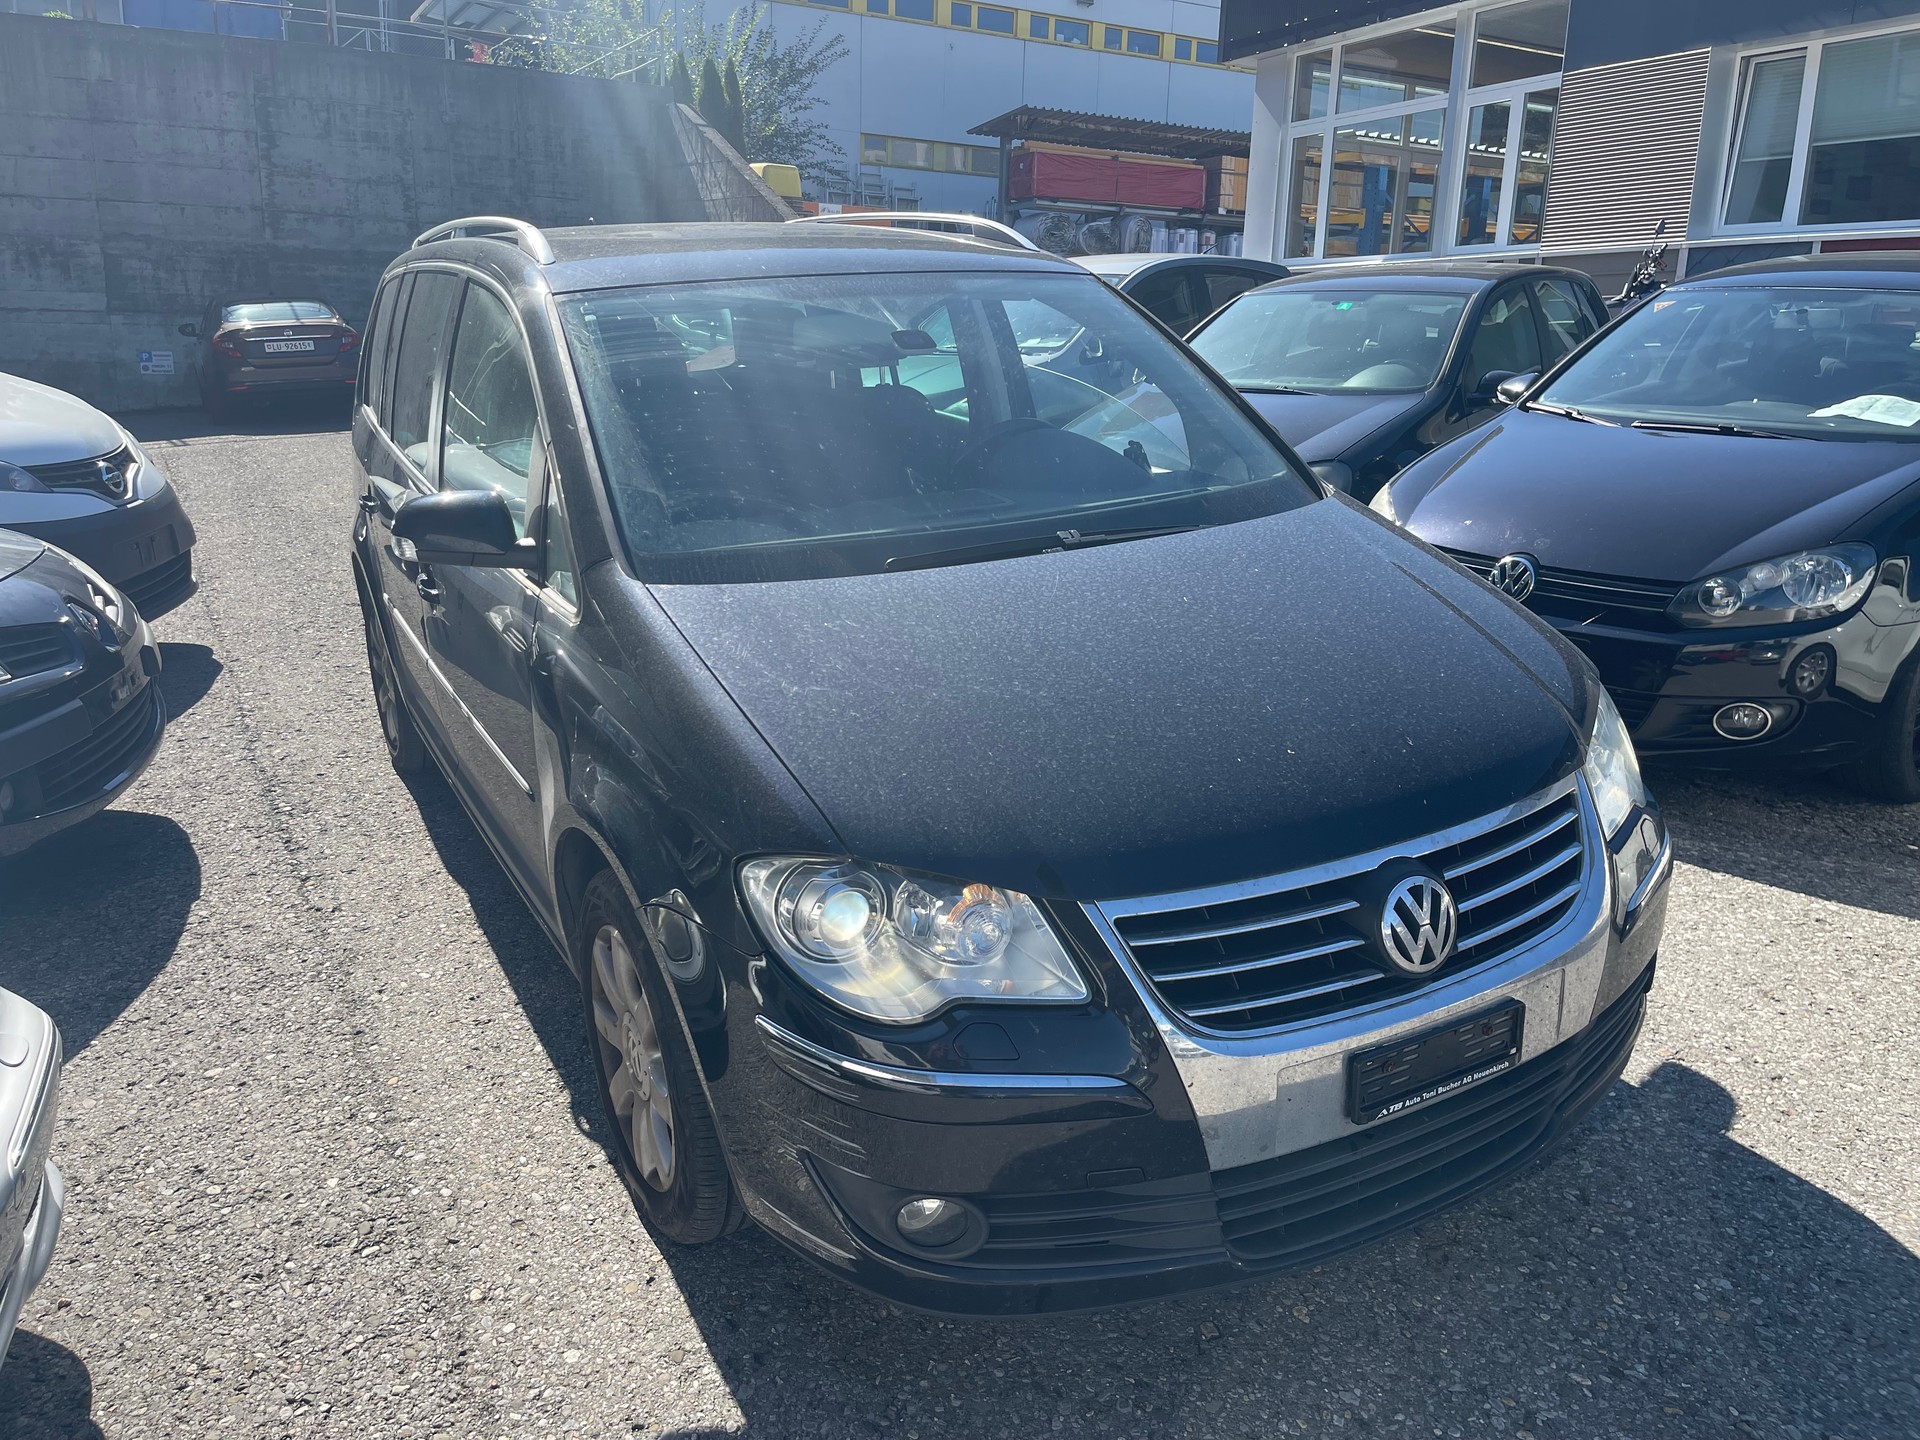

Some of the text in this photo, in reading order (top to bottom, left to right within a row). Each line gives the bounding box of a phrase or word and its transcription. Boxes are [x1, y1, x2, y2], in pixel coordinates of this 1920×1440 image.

[272, 343, 282, 351] LU
[1384, 878, 1454, 971] VW
[1404, 1096, 1421, 1108] Auto
[1422, 1088, 1437, 1100] Toni
[1437, 1080, 1462, 1095] Bucher
[1462, 1075, 1473, 1085] AG
[1473, 1061, 1509, 1081] Neuenkirch
